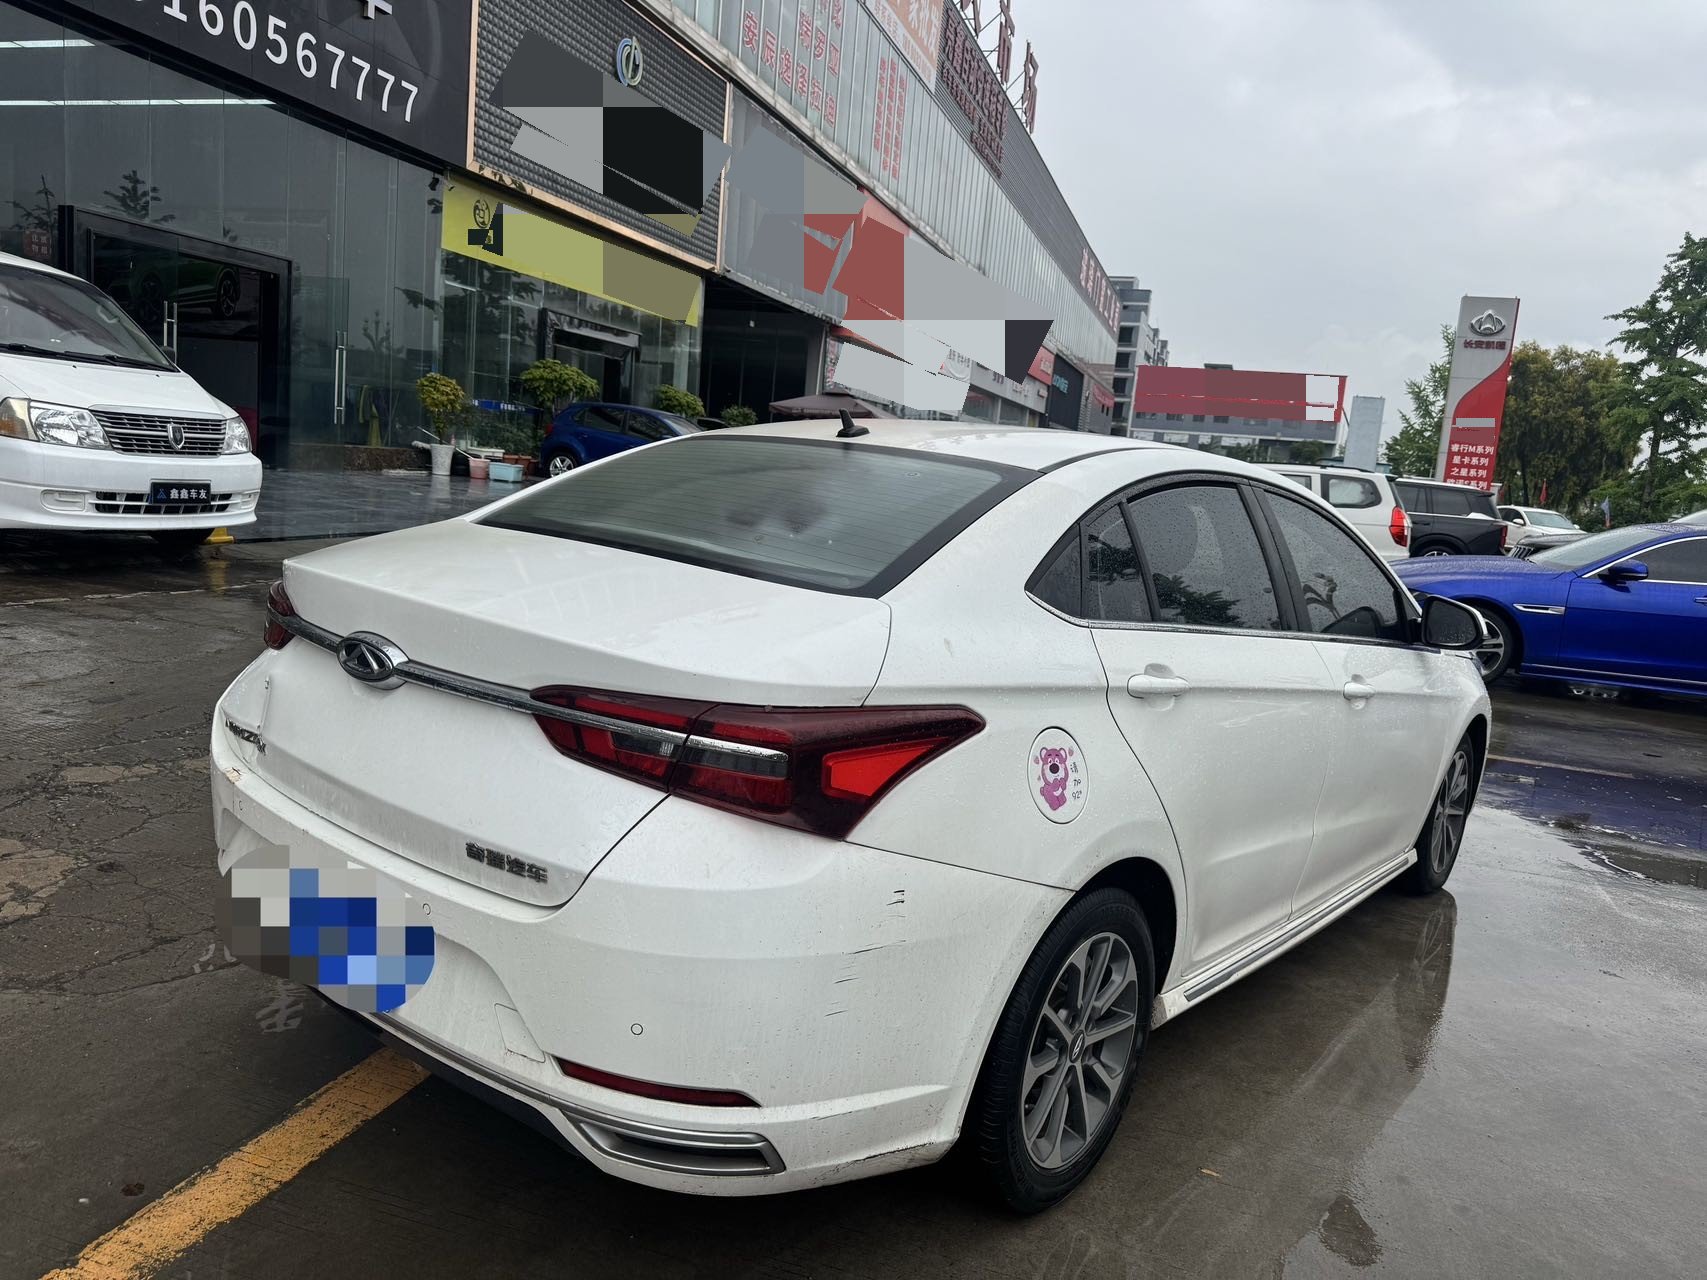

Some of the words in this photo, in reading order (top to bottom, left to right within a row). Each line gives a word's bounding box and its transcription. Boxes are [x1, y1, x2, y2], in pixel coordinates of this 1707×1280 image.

[135, 0, 418, 123] 160567777
[1452, 455, 1489, 467] 星卡系列
[1450, 467, 1487, 479] 之星系列
[170, 488, 207, 499] 鑫鑫车友
[465, 841, 548, 884] 奇瑞汽车
